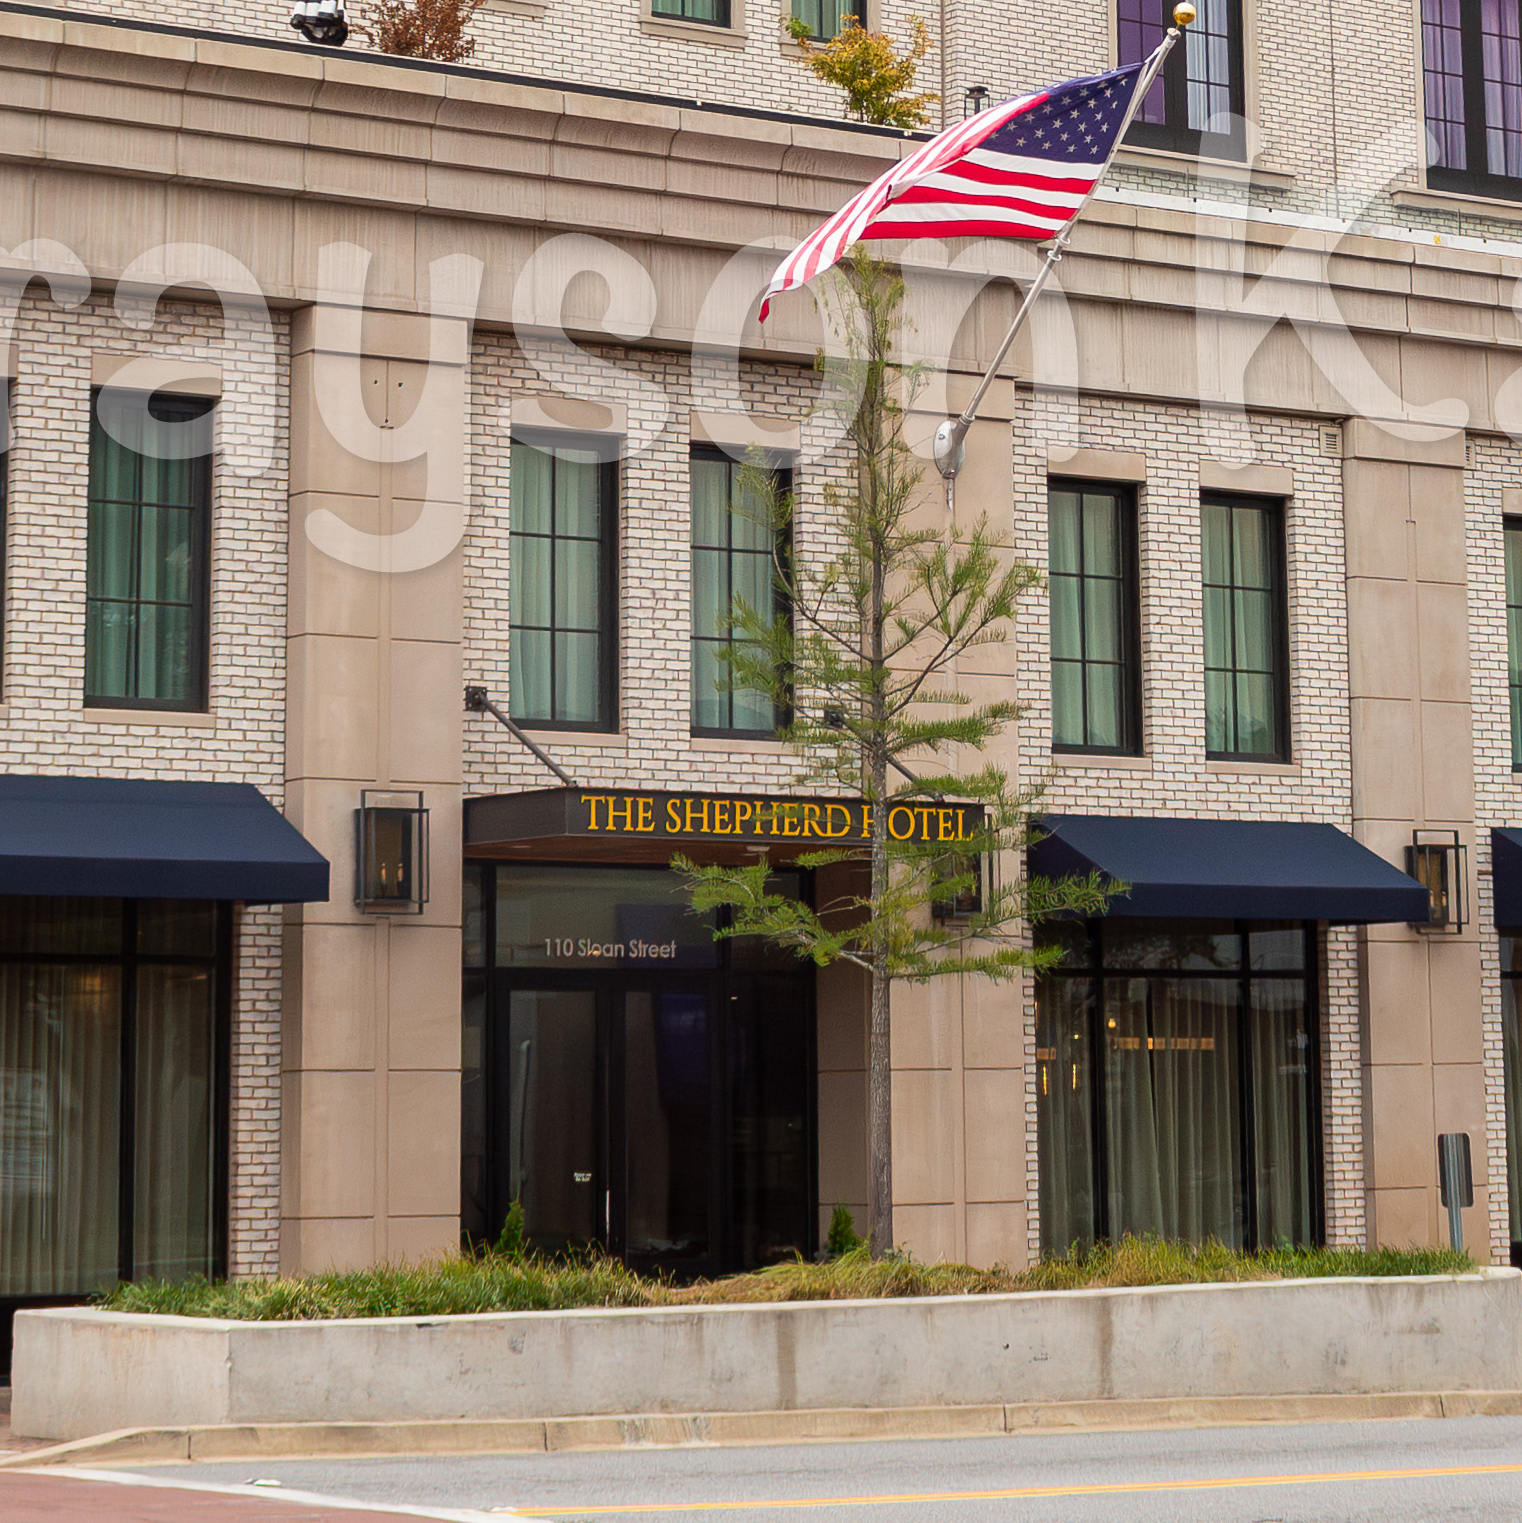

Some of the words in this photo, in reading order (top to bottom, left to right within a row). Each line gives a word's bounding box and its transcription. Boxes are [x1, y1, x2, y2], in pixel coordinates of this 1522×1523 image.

[581, 795, 655, 832] THE
[665, 799, 852, 838] SHEPHERD
[545, 939, 574, 957] 110
[578, 939, 624, 958] Sloan
[629, 939, 677, 958] Street
